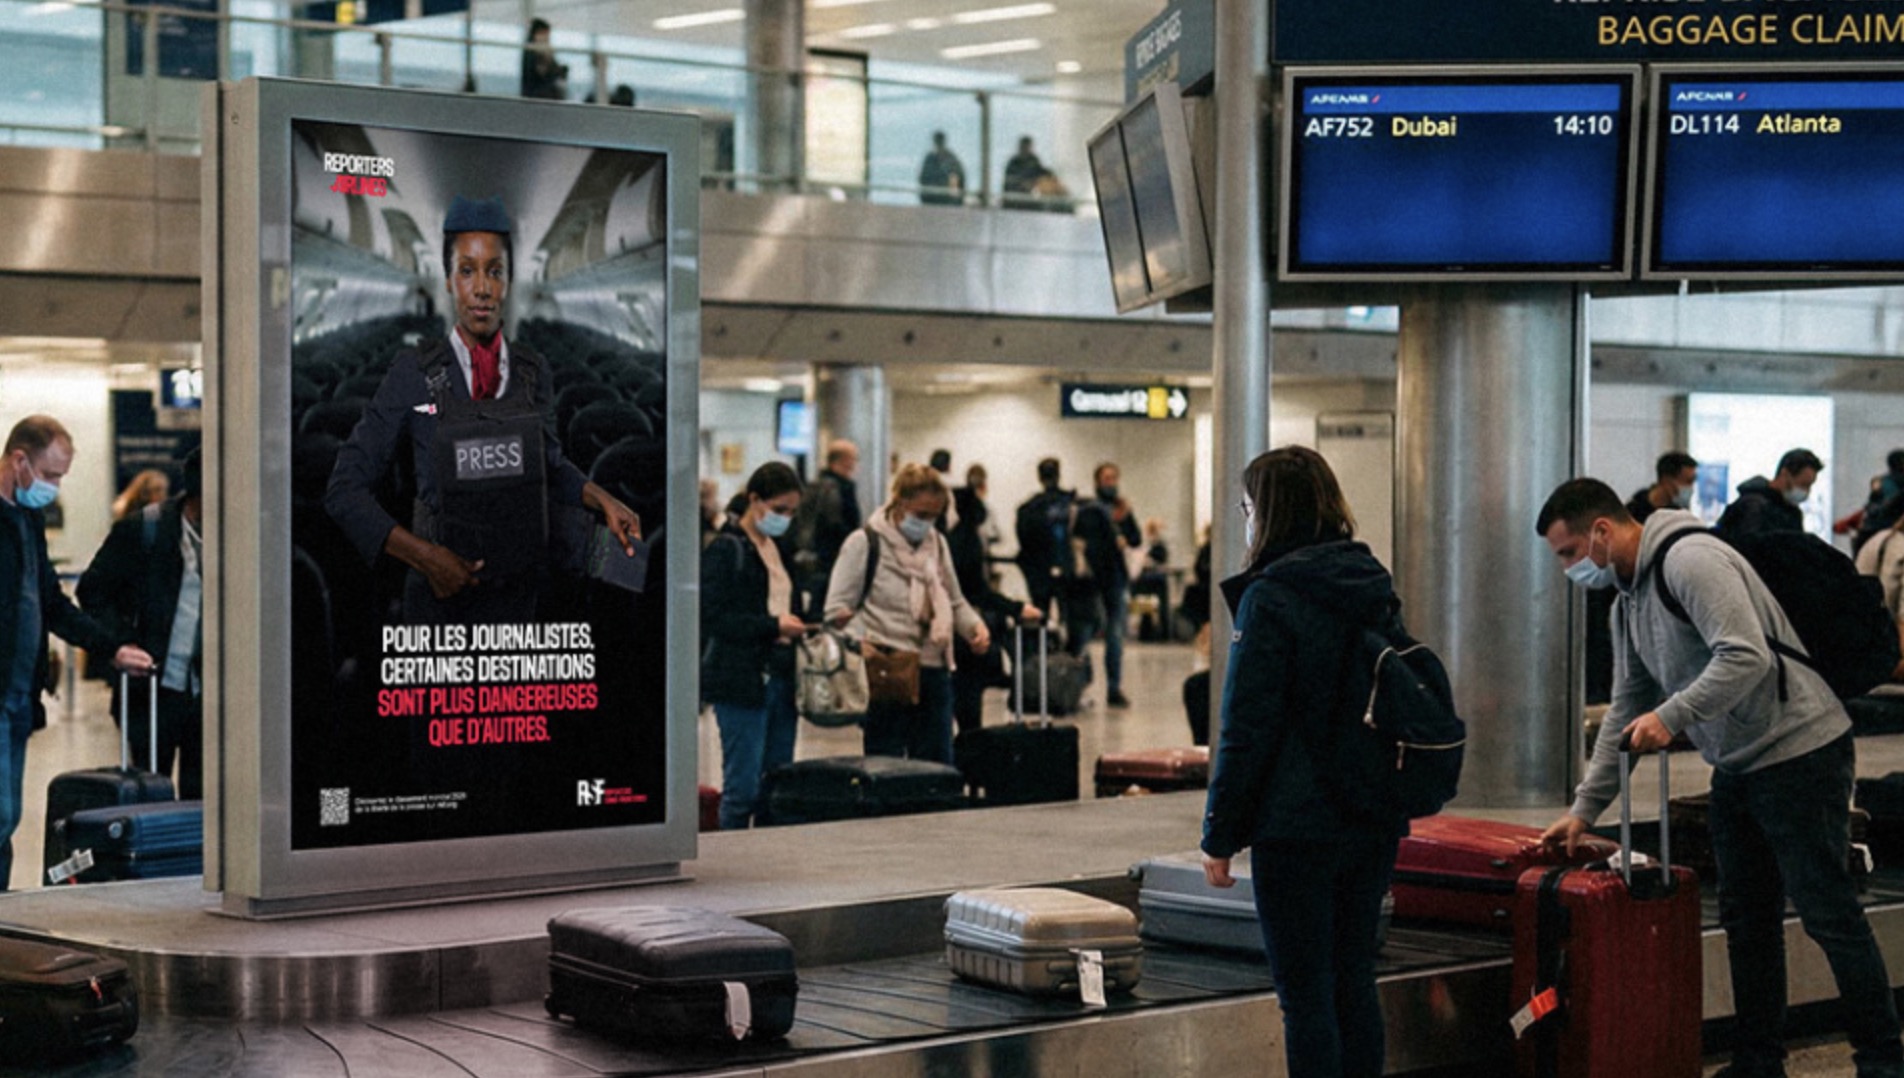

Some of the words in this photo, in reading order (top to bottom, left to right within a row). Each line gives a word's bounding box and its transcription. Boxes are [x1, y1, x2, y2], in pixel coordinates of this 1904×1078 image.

[1598, 14, 1778, 45] BAGGAGE
[1791, 13, 1904, 44] CLAIM
[1305, 117, 1374, 137] AF752
[1391, 116, 1457, 137] Dubai
[1553, 115, 1613, 136] 14:10
[1670, 114, 1740, 135] DL114
[1756, 113, 1842, 134] Atlanta
[324, 151, 395, 177] REPORTERS
[456, 441, 522, 473] PRESS
[382, 625, 431, 652] POUR
[434, 625, 467, 651] LES
[381, 656, 474, 685] CERTAINES
[478, 653, 595, 682] DESTINATIONS
[378, 688, 426, 717] SONT
[430, 687, 475, 715] PLUS
[478, 683, 598, 713] DANGEREUSES
[428, 718, 464, 747] QUE
[466, 715, 550, 744] D'AUTRES.
